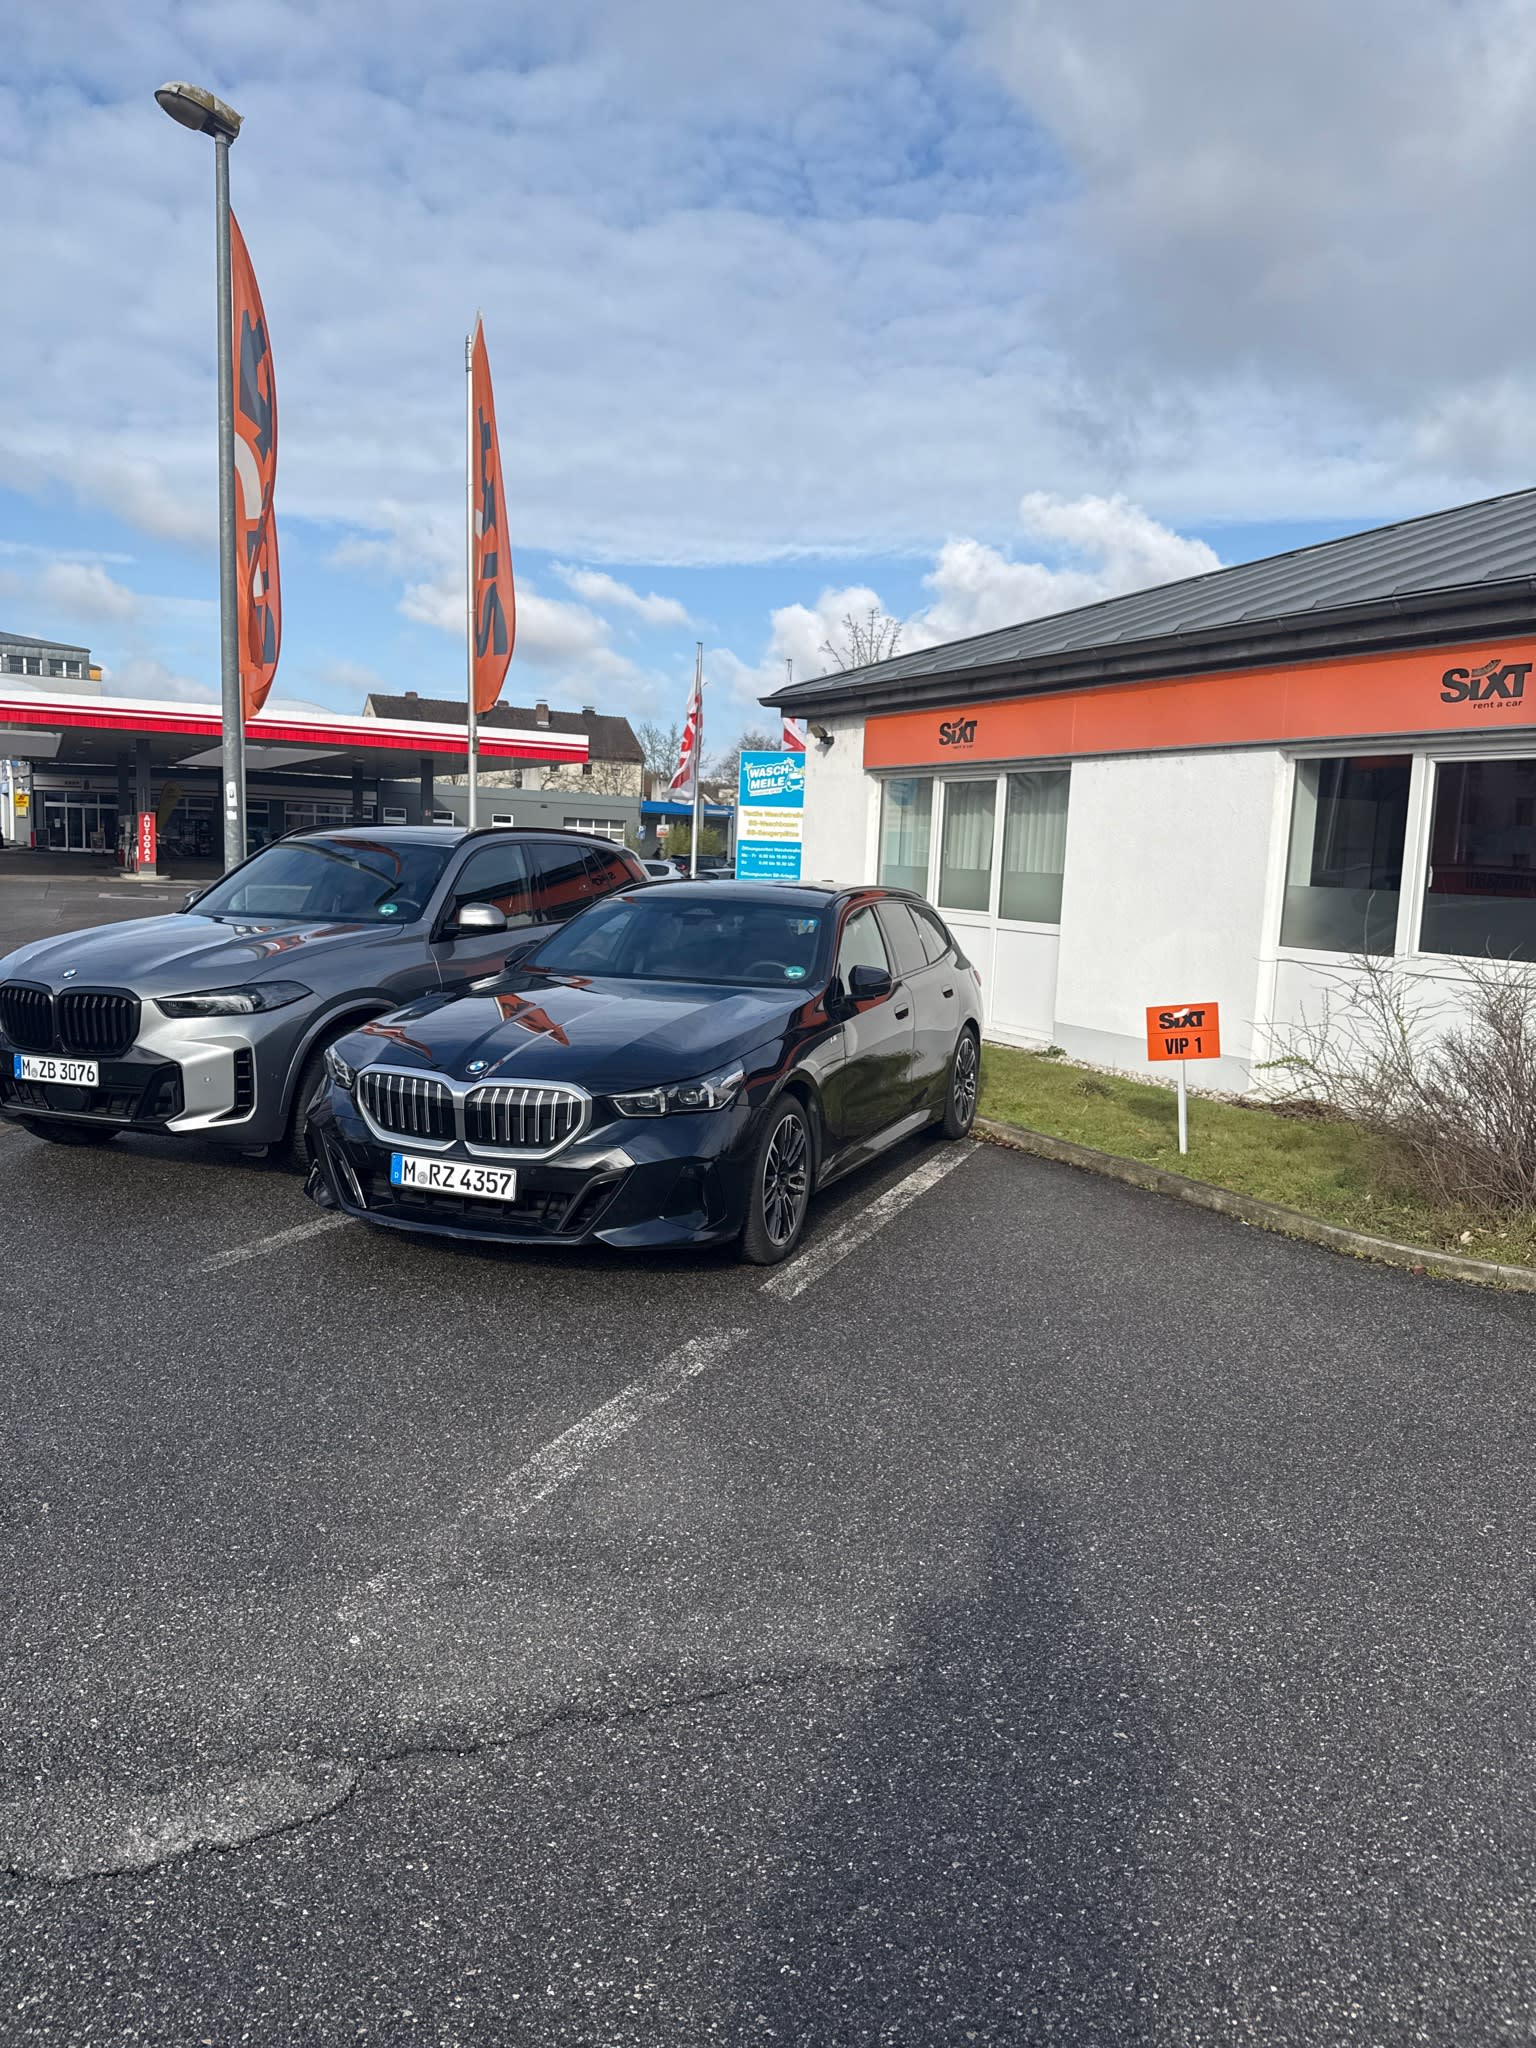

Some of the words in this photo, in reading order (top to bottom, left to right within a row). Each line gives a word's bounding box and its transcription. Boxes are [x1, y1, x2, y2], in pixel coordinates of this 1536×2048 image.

[1440, 659, 1533, 703] SIXT
[1473, 702, 1495, 710] rent
[1506, 700, 1523, 708] car
[939, 717, 978, 745] SIXT
[749, 764, 793, 778] WASCH-
[750, 776, 786, 789] MEILE
[143, 814, 151, 862] AUTOGAS
[1159, 1008, 1205, 1029] SIXT
[1165, 1038, 1189, 1055] VIP
[1194, 1036, 1202, 1053] 1
[22, 1058, 31, 1077] M
[39, 1060, 57, 1079] ZB
[60, 1062, 96, 1083] 3076
[404, 1160, 416, 1182] M
[429, 1163, 455, 1188] RZ
[460, 1169, 512, 1195] 4357
